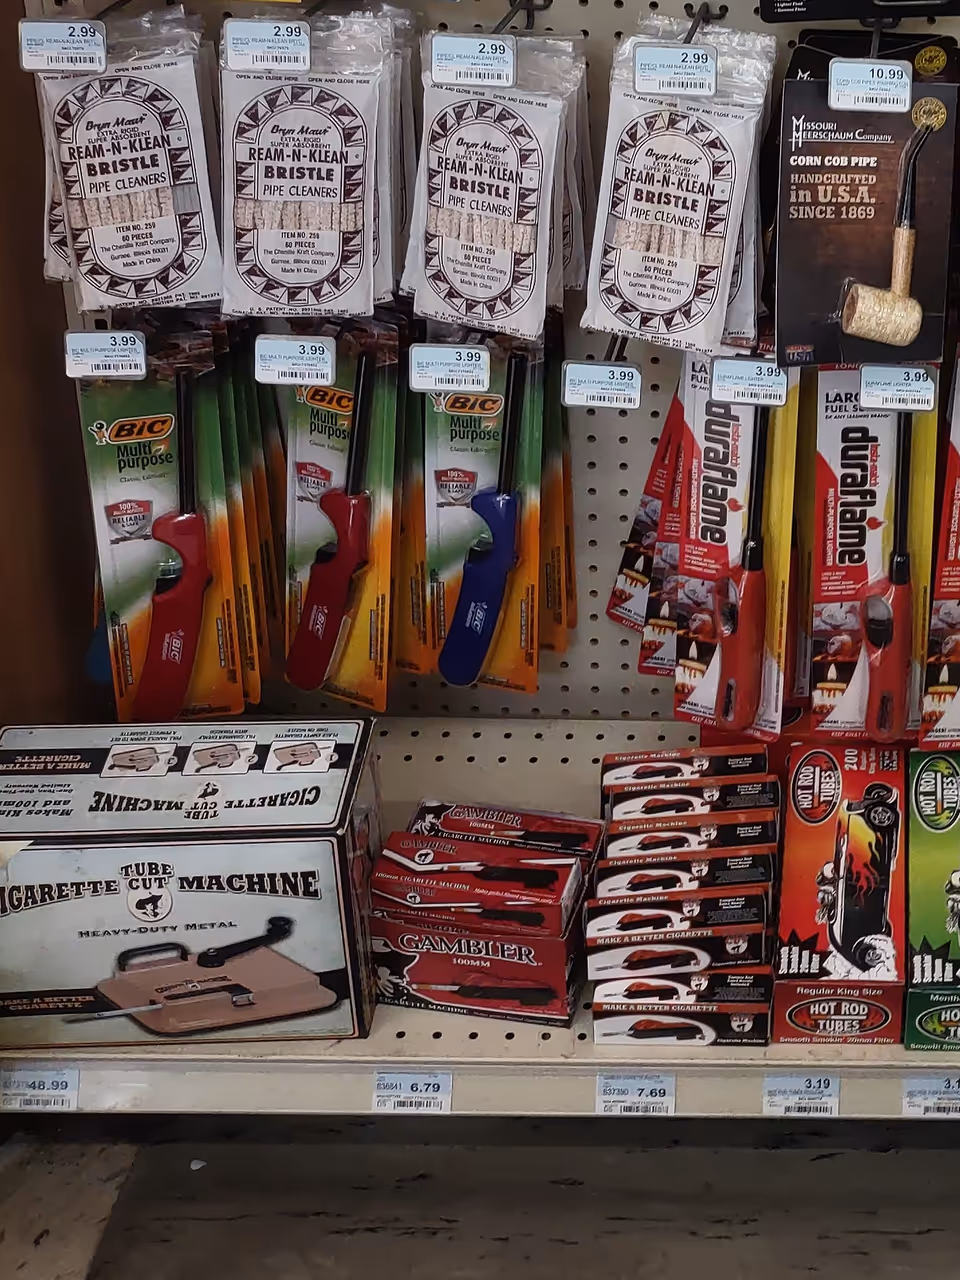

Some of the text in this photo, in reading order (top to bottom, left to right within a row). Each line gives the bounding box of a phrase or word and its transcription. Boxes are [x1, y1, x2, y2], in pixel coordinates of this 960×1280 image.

[68, 26, 96, 38] 2.99
[680, 52, 709, 64] 2.99
[869, 68, 904, 80] 10.99
[249, 148, 349, 164] REAM-N-KLEAN
[790, 156, 877, 167] CORN COB PIPE
[263, 166, 334, 182] BRISTLE
[790, 174, 876, 184] HANDCRAFTED
[263, 184, 338, 198] PIPE CLEANERS
[790, 186, 876, 203] in U.S.A.
[789, 206, 875, 219] SINCE 1869
[109, 336, 136, 347] 3.99
[455, 351, 481, 362] 3.99
[755, 366, 781, 378] 3.99
[117, 442, 152, 459] Multi
[118, 452, 174, 473] purpose
[837, 426, 879, 567] duraflame
[120, 862, 174, 877] TUBE
[127, 877, 169, 890] CUT
[178, 871, 321, 898] MACHINE
[78, 924, 178, 938] HEAVY-DUTY
[399, 933, 537, 965] GAMBLER
[452, 958, 491, 968] 100MM
[602, 1004, 626, 1012] MAKE
[638, 1004, 670, 1012] BETTER
[672, 1004, 718, 1012] CIGARETTE
[810, 1003, 869, 1017] HOT ROD
[817, 1020, 860, 1033] TUBES
[410, 1080, 441, 1092] 6.79
[804, 1078, 830, 1089] 3.19
[636, 1087, 666, 1098] 7.69
